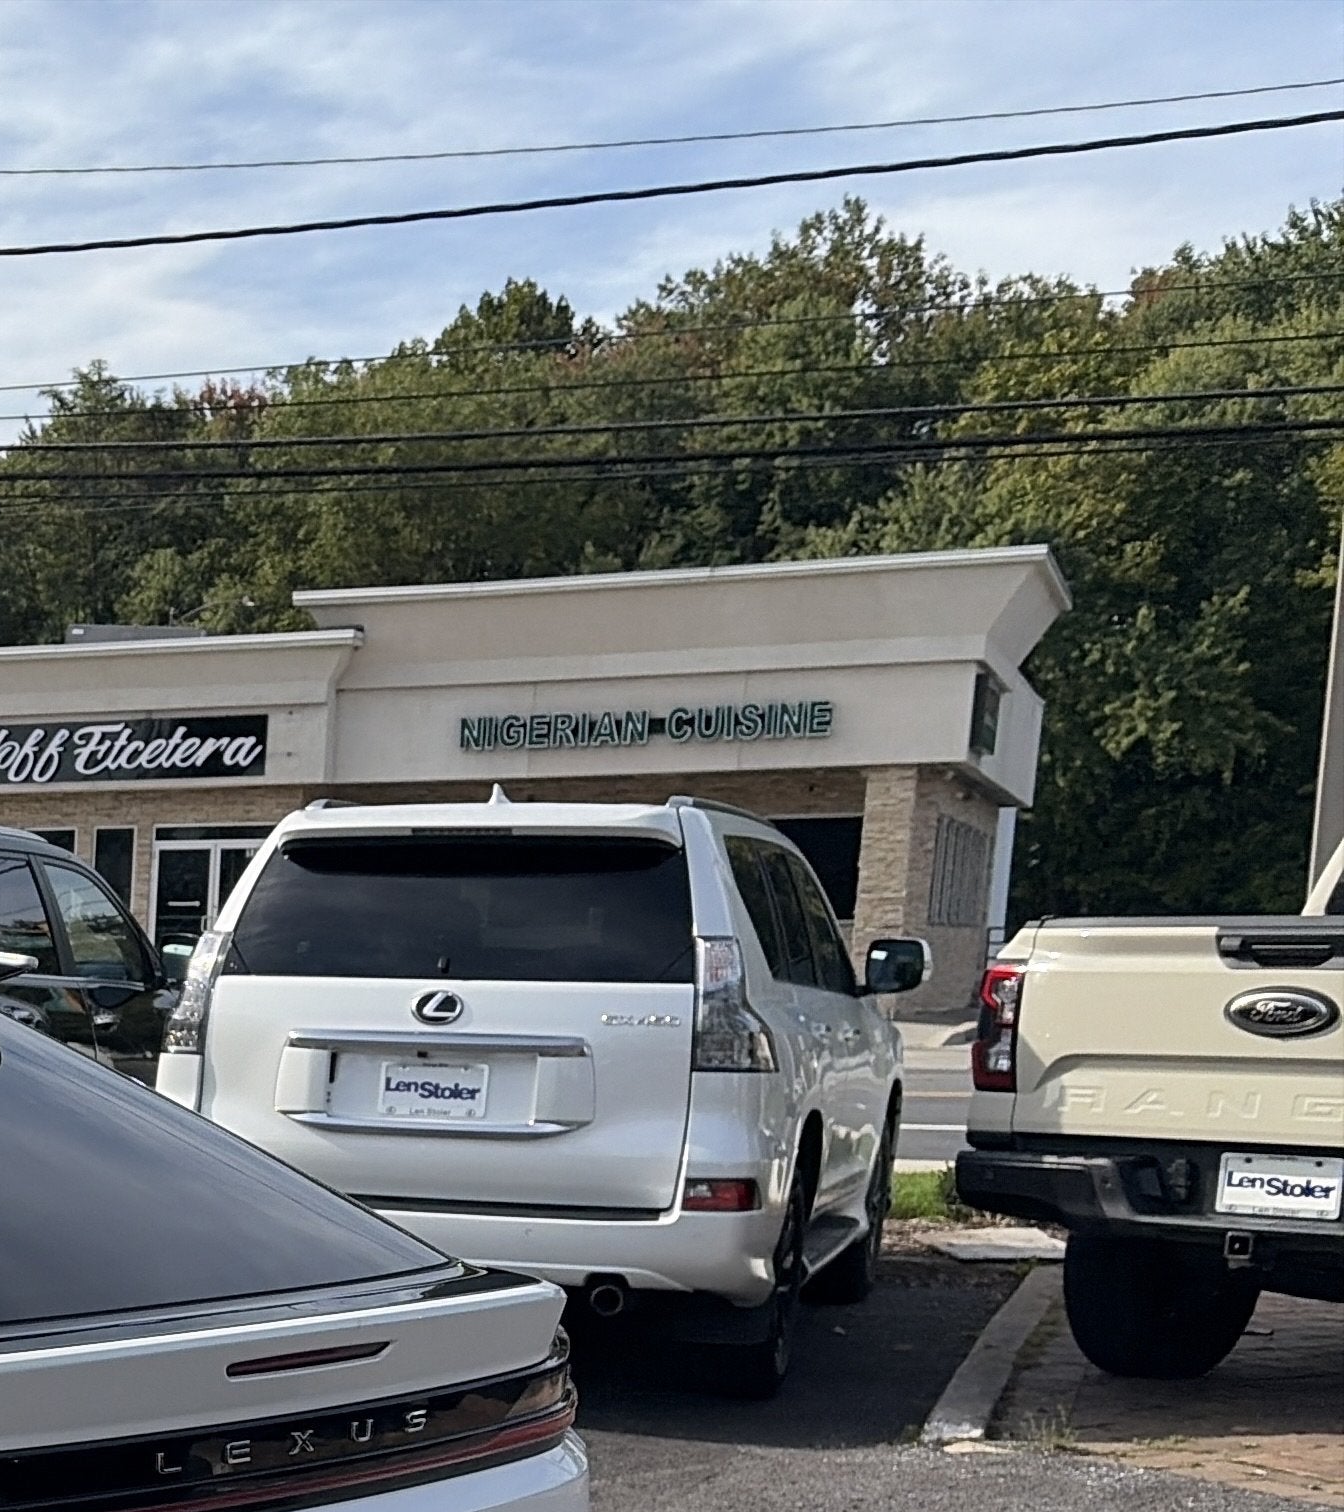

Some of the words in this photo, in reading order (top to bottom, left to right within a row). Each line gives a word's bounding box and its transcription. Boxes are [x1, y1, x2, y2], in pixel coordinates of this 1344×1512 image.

[72, 722, 263, 775] Etcetera
[459, 708, 650, 752] NIGERIAN
[665, 700, 834, 743] CUISINE
[1250, 999, 1305, 1024] Ford
[154, 1408, 430, 1474] LEXUS
